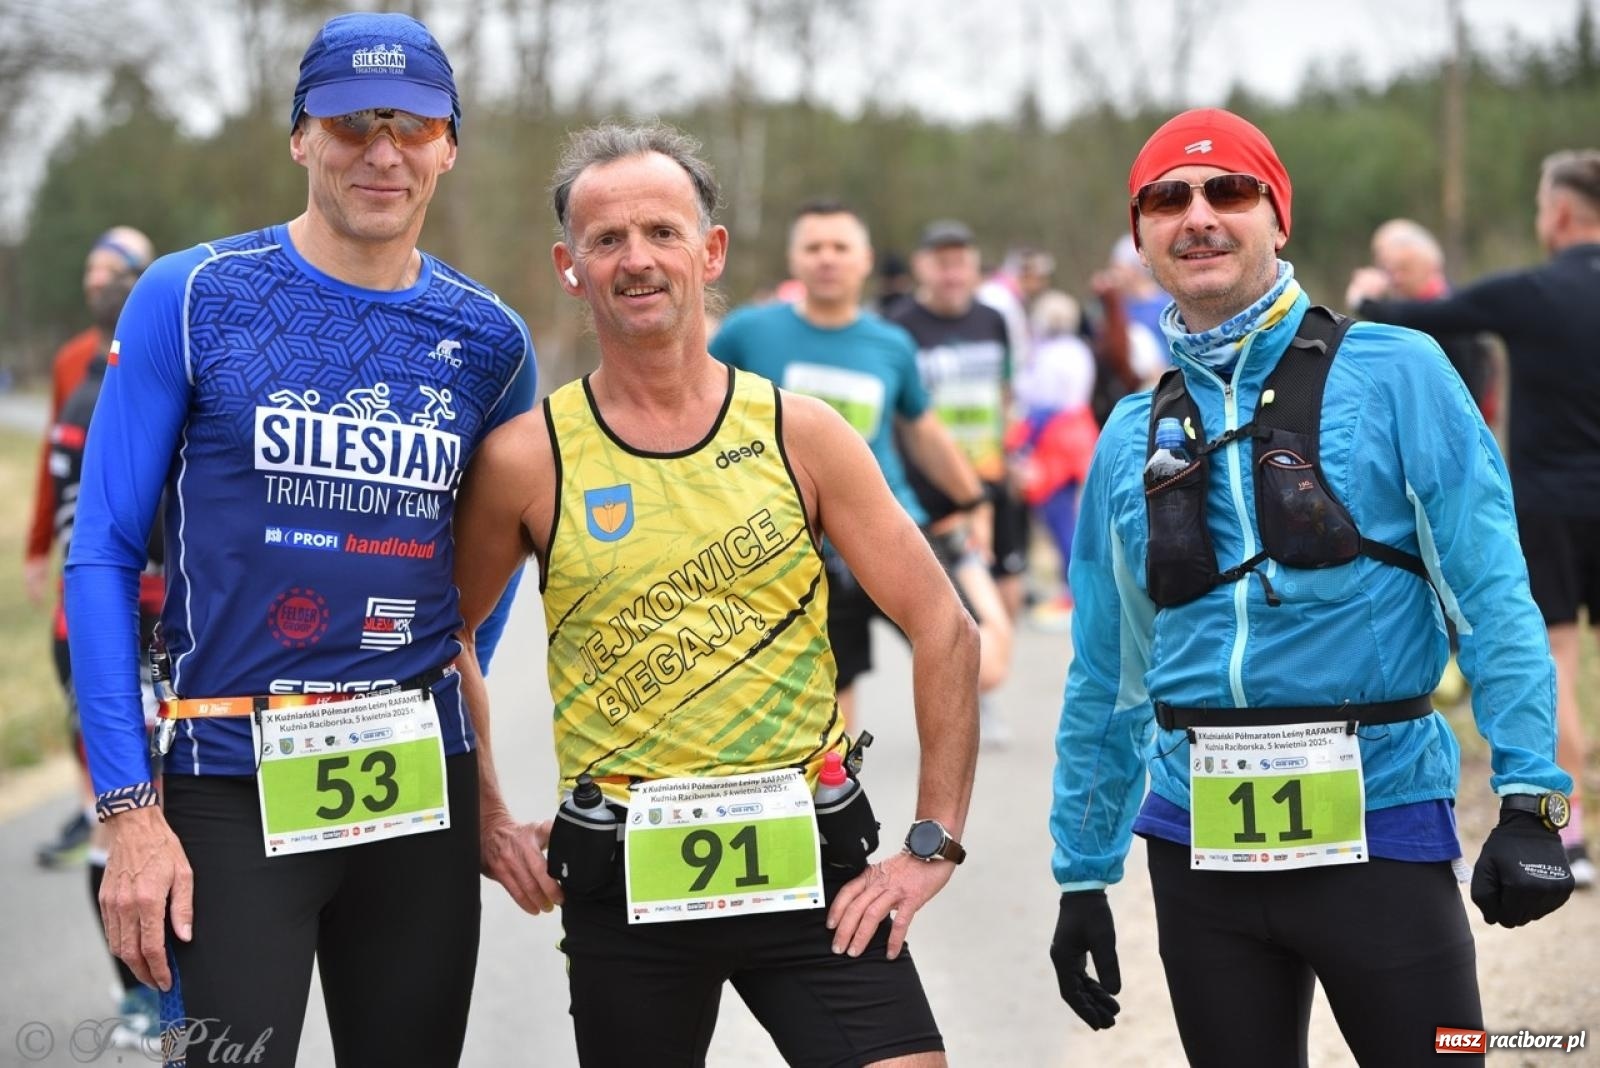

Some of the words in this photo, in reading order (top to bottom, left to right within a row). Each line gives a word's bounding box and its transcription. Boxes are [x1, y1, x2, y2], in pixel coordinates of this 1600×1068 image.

[354, 54, 404, 67] SILESIAN
[261, 414, 456, 487] SILESIAN
[715, 440, 765, 469] deep
[264, 475, 391, 515] TRIATHLON
[396, 489, 440, 520] TEAM
[293, 532, 338, 549] PROFI
[345, 533, 436, 560] handlobud
[578, 508, 784, 685] JEJKOWICE
[596, 593, 766, 726] BIEGAJĄ
[267, 715, 273, 723] X
[321, 704, 367, 716] Półmaraton
[388, 695, 422, 705] RAFAMET
[356, 715, 361, 723] 5
[362, 711, 391, 721] kwietnia
[393, 708, 410, 717] 2025
[1235, 731, 1280, 740] Półmaraton
[1305, 726, 1344, 736] RAFAMET
[1267, 742, 1273, 750] 5
[1274, 740, 1307, 749] kwietnia
[1309, 738, 1327, 747] 2025
[316, 750, 399, 820] 53
[730, 786, 761, 796] kwietnia
[763, 784, 782, 793] 2025
[760, 773, 797, 784] RAFAMET
[1228, 779, 1312, 843] 11
[681, 825, 769, 892] 91
